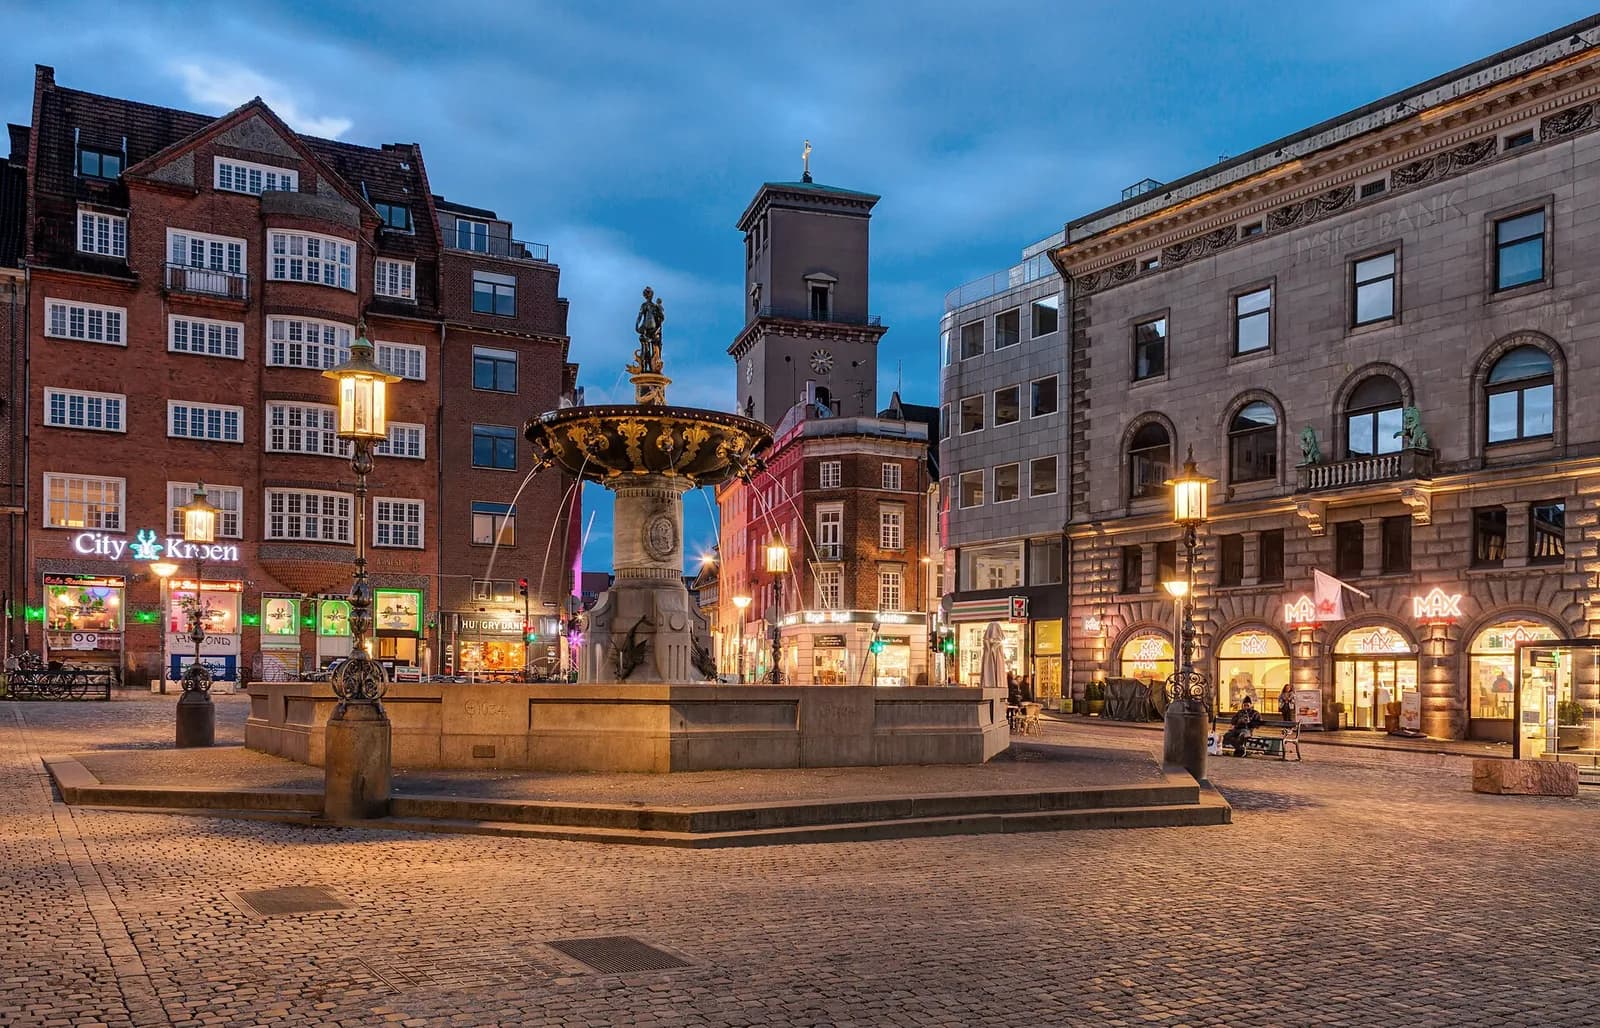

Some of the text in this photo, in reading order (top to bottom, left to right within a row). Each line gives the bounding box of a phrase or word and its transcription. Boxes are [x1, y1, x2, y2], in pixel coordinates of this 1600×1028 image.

[1379, 189, 1467, 238] BANK
[75, 533, 127, 559] City
[1413, 587, 1462, 618] MAX
[1241, 634, 1268, 655] MAX
[1361, 630, 1393, 651] MAX
